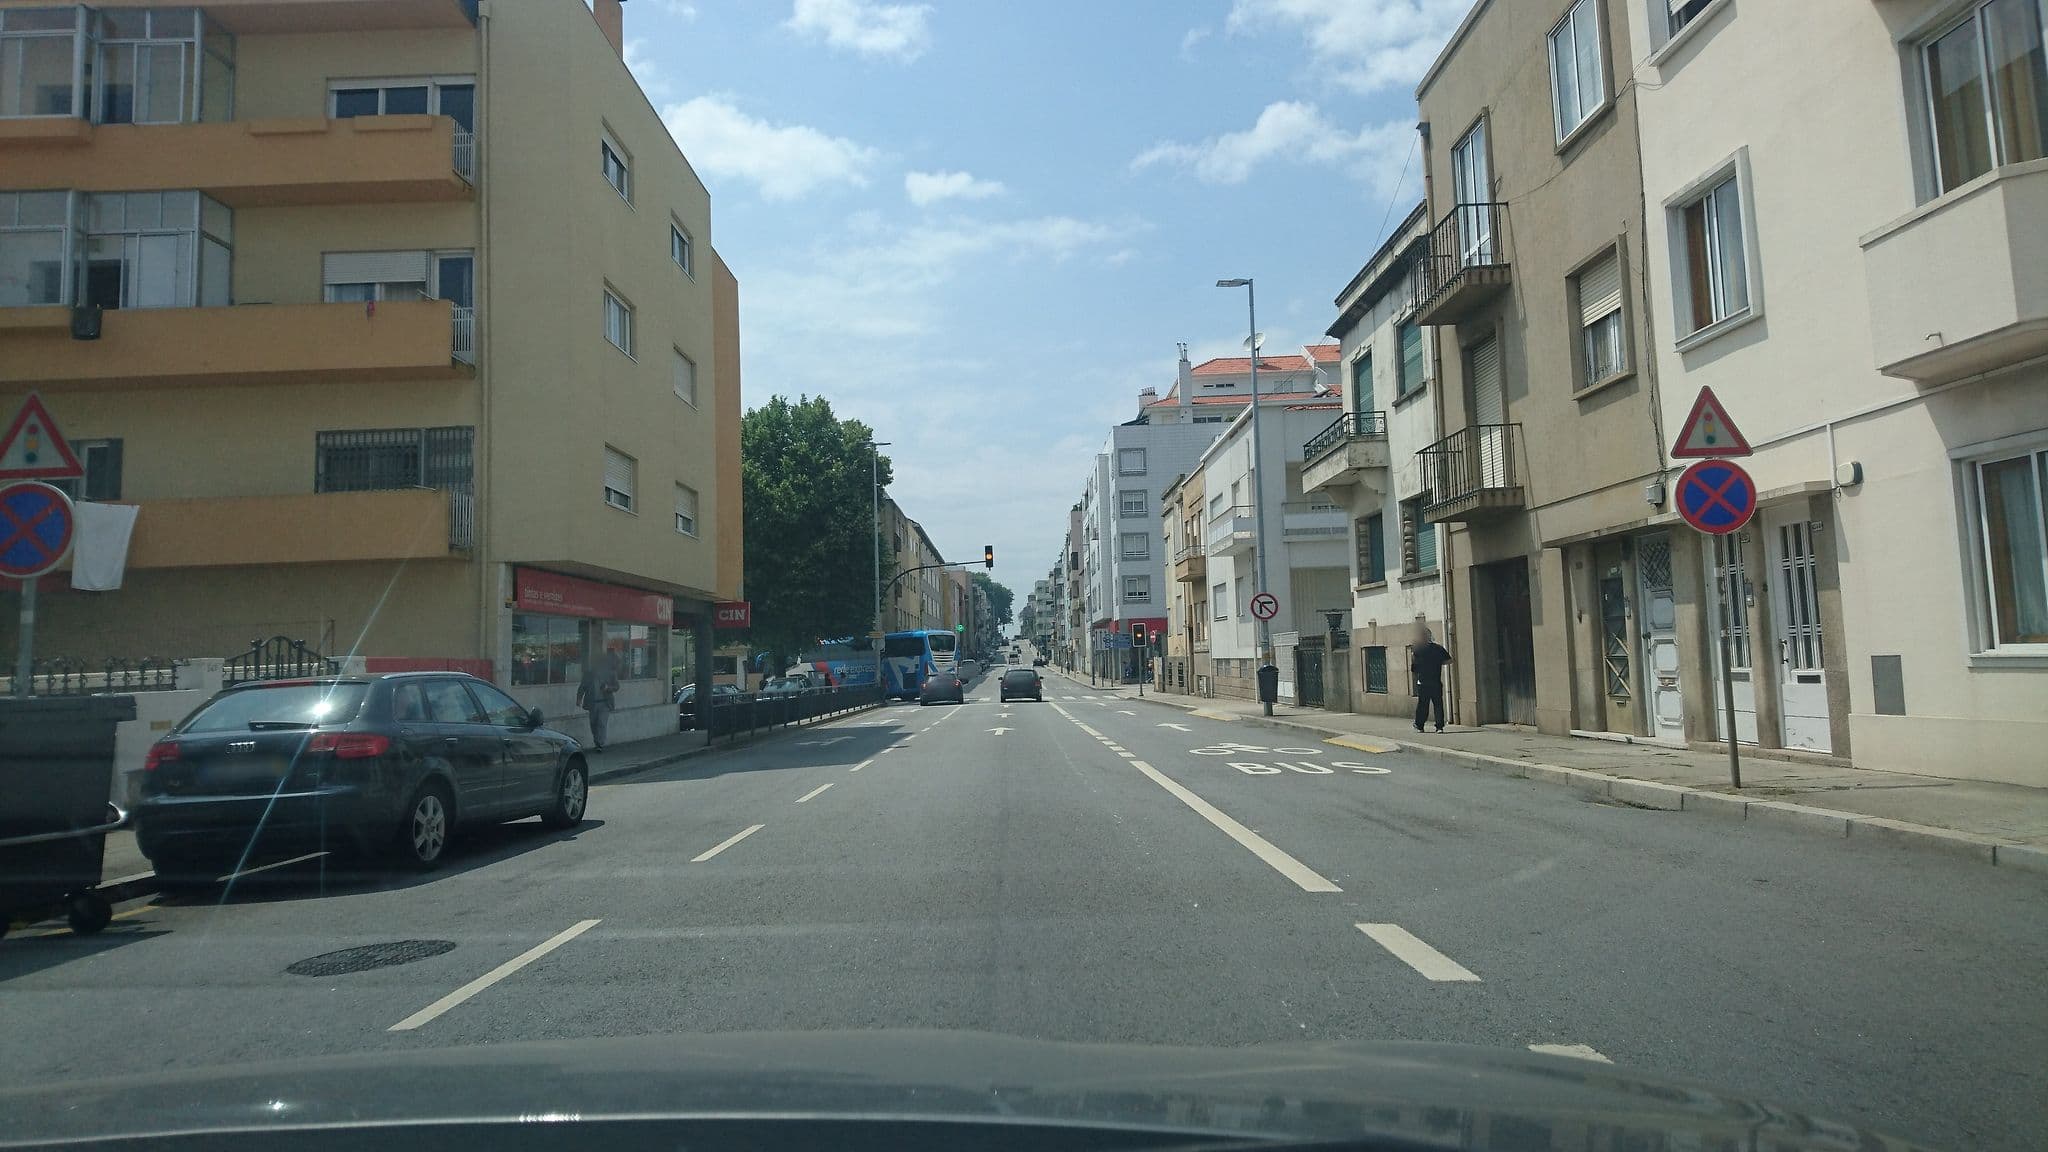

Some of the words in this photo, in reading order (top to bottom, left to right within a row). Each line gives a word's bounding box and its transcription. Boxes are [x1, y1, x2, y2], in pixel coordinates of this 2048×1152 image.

[656, 598, 672, 621] CIN
[718, 608, 746, 621] CIN
[1225, 761, 1392, 775] BUS
